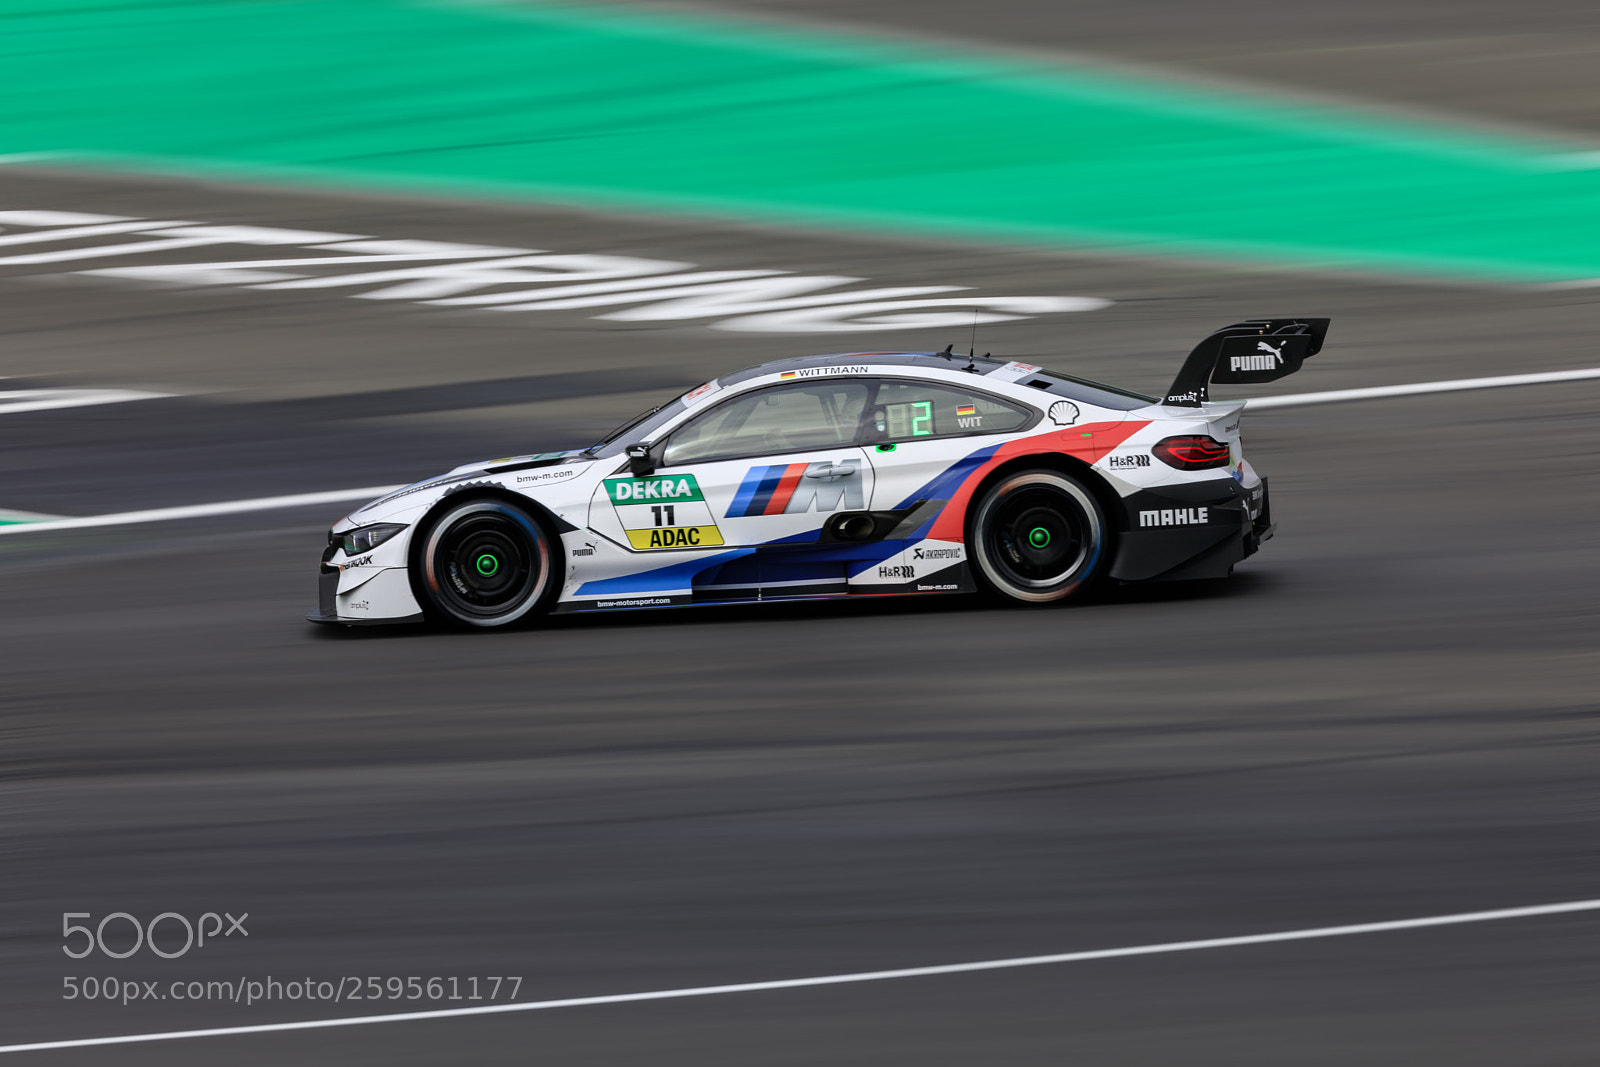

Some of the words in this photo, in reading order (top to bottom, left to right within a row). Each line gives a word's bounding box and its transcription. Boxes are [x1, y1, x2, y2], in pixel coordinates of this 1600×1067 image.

[1230, 355, 1276, 372] PUMA
[799, 366, 868, 377] WITTMANN
[911, 401, 931, 436] 2
[957, 416, 983, 429] WIT
[1110, 456, 1134, 467] H&R
[517, 470, 573, 483] bmw-m.com
[615, 479, 692, 501] DEKRA
[651, 505, 675, 527] 11
[1139, 507, 1208, 527] MAHLE
[650, 528, 700, 547] ADAC
[572, 548, 594, 557] PUMA
[879, 566, 901, 578] H&R
[597, 597, 671, 608] bmw-motorsport.com
